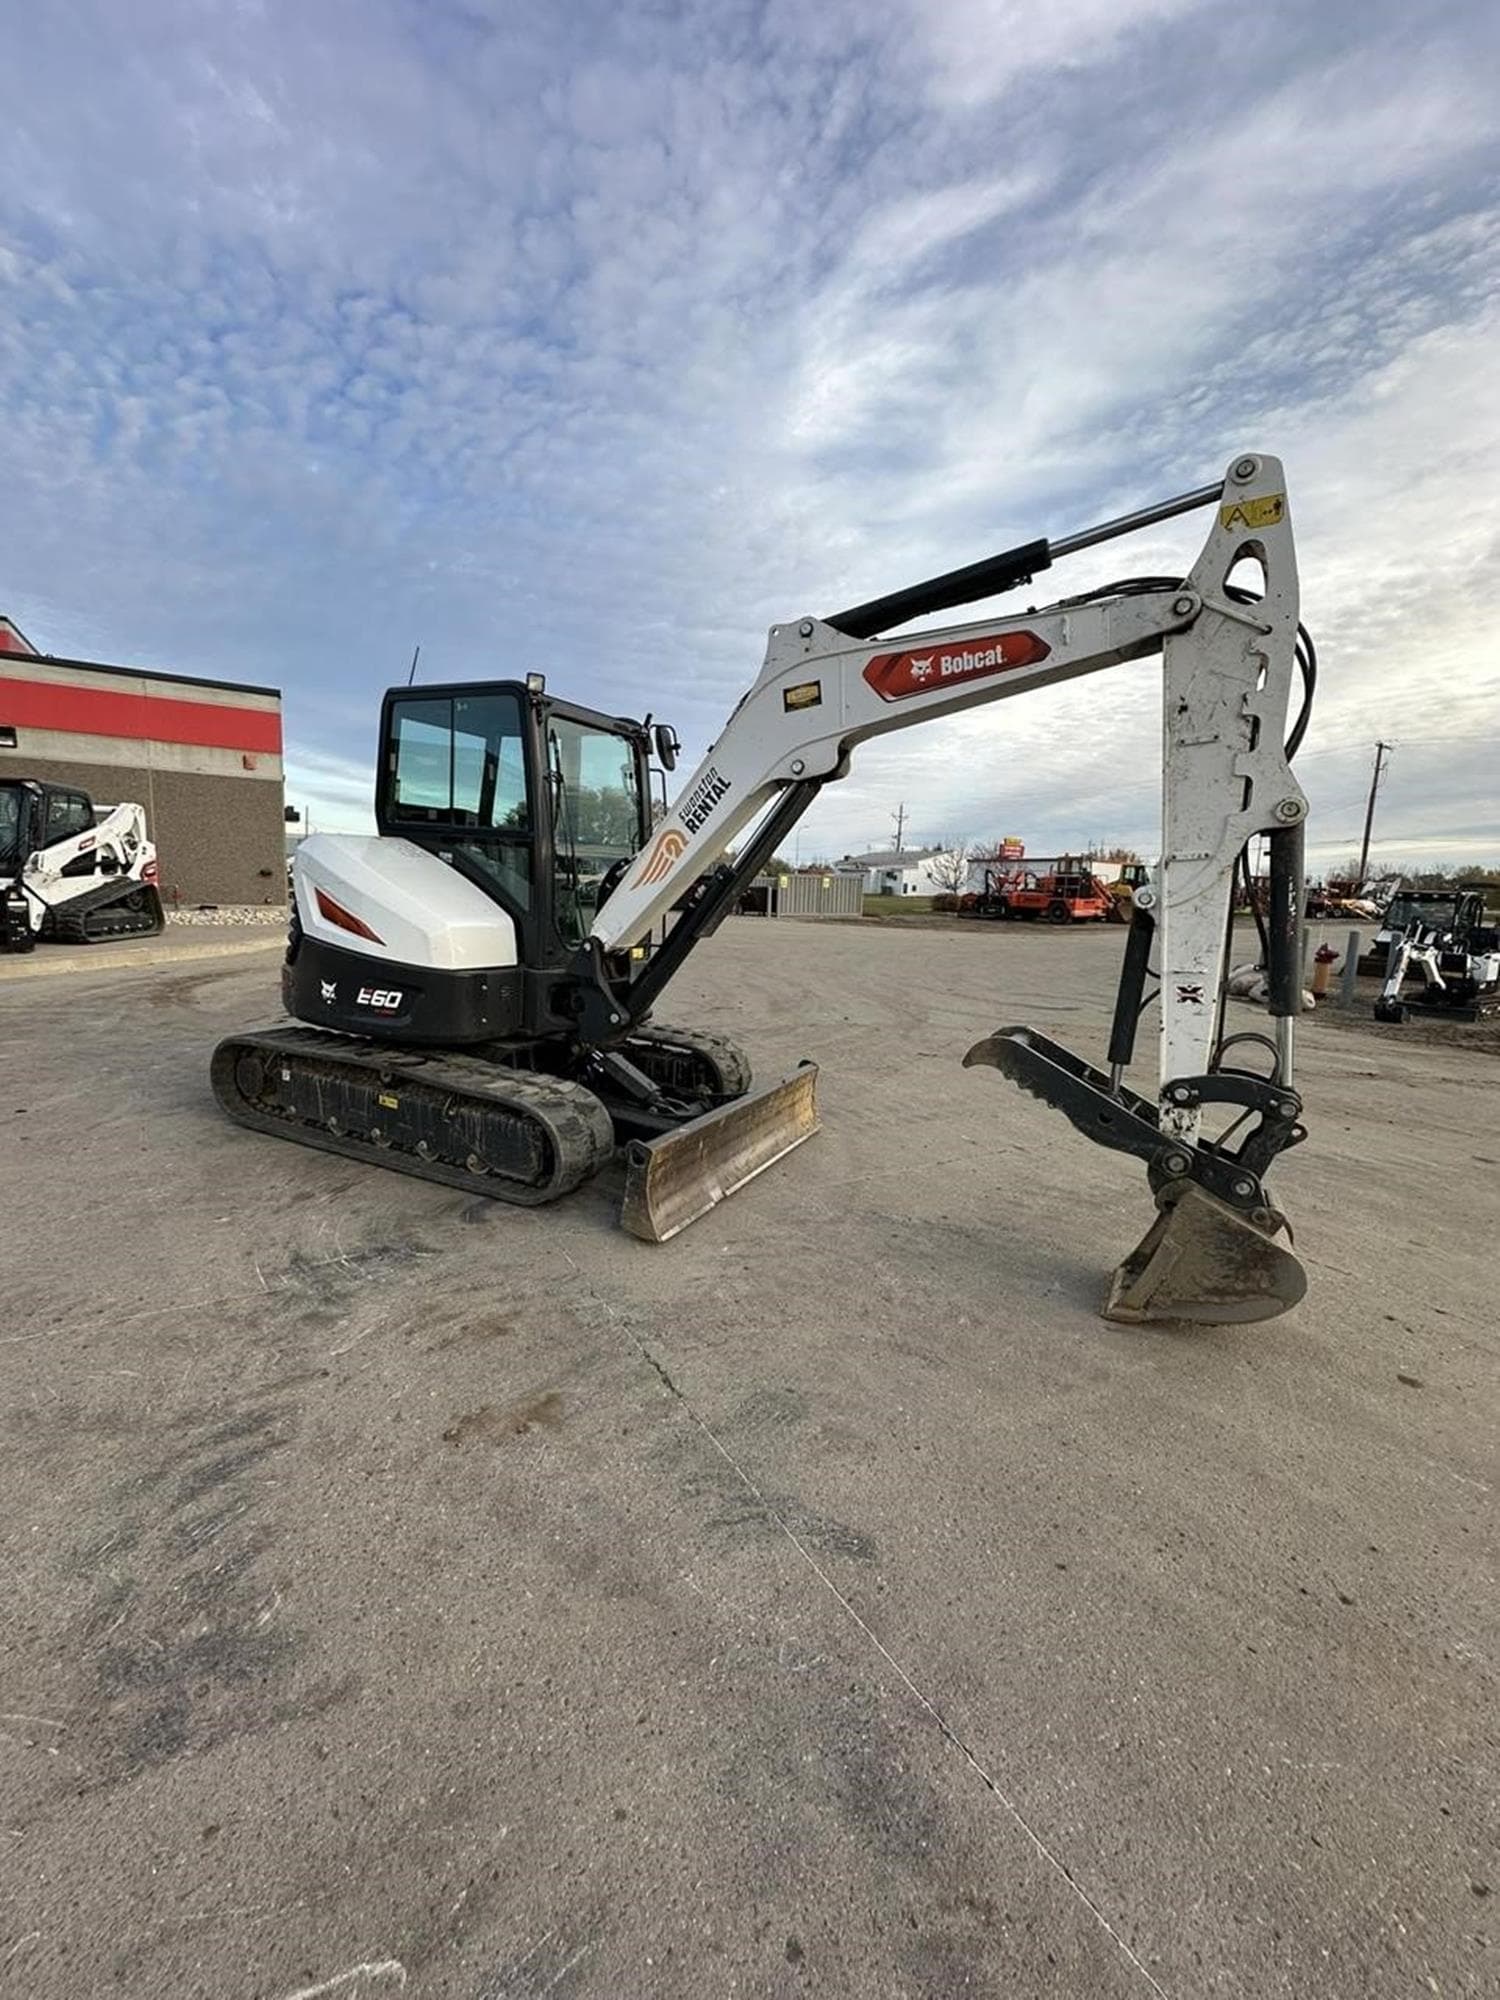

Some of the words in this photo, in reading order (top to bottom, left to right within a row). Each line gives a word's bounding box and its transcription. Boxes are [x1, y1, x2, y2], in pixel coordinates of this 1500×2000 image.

[940, 645, 1003, 676] Bobcat
[684, 776, 732, 835] RENTAL
[356, 987, 403, 1008] E60
